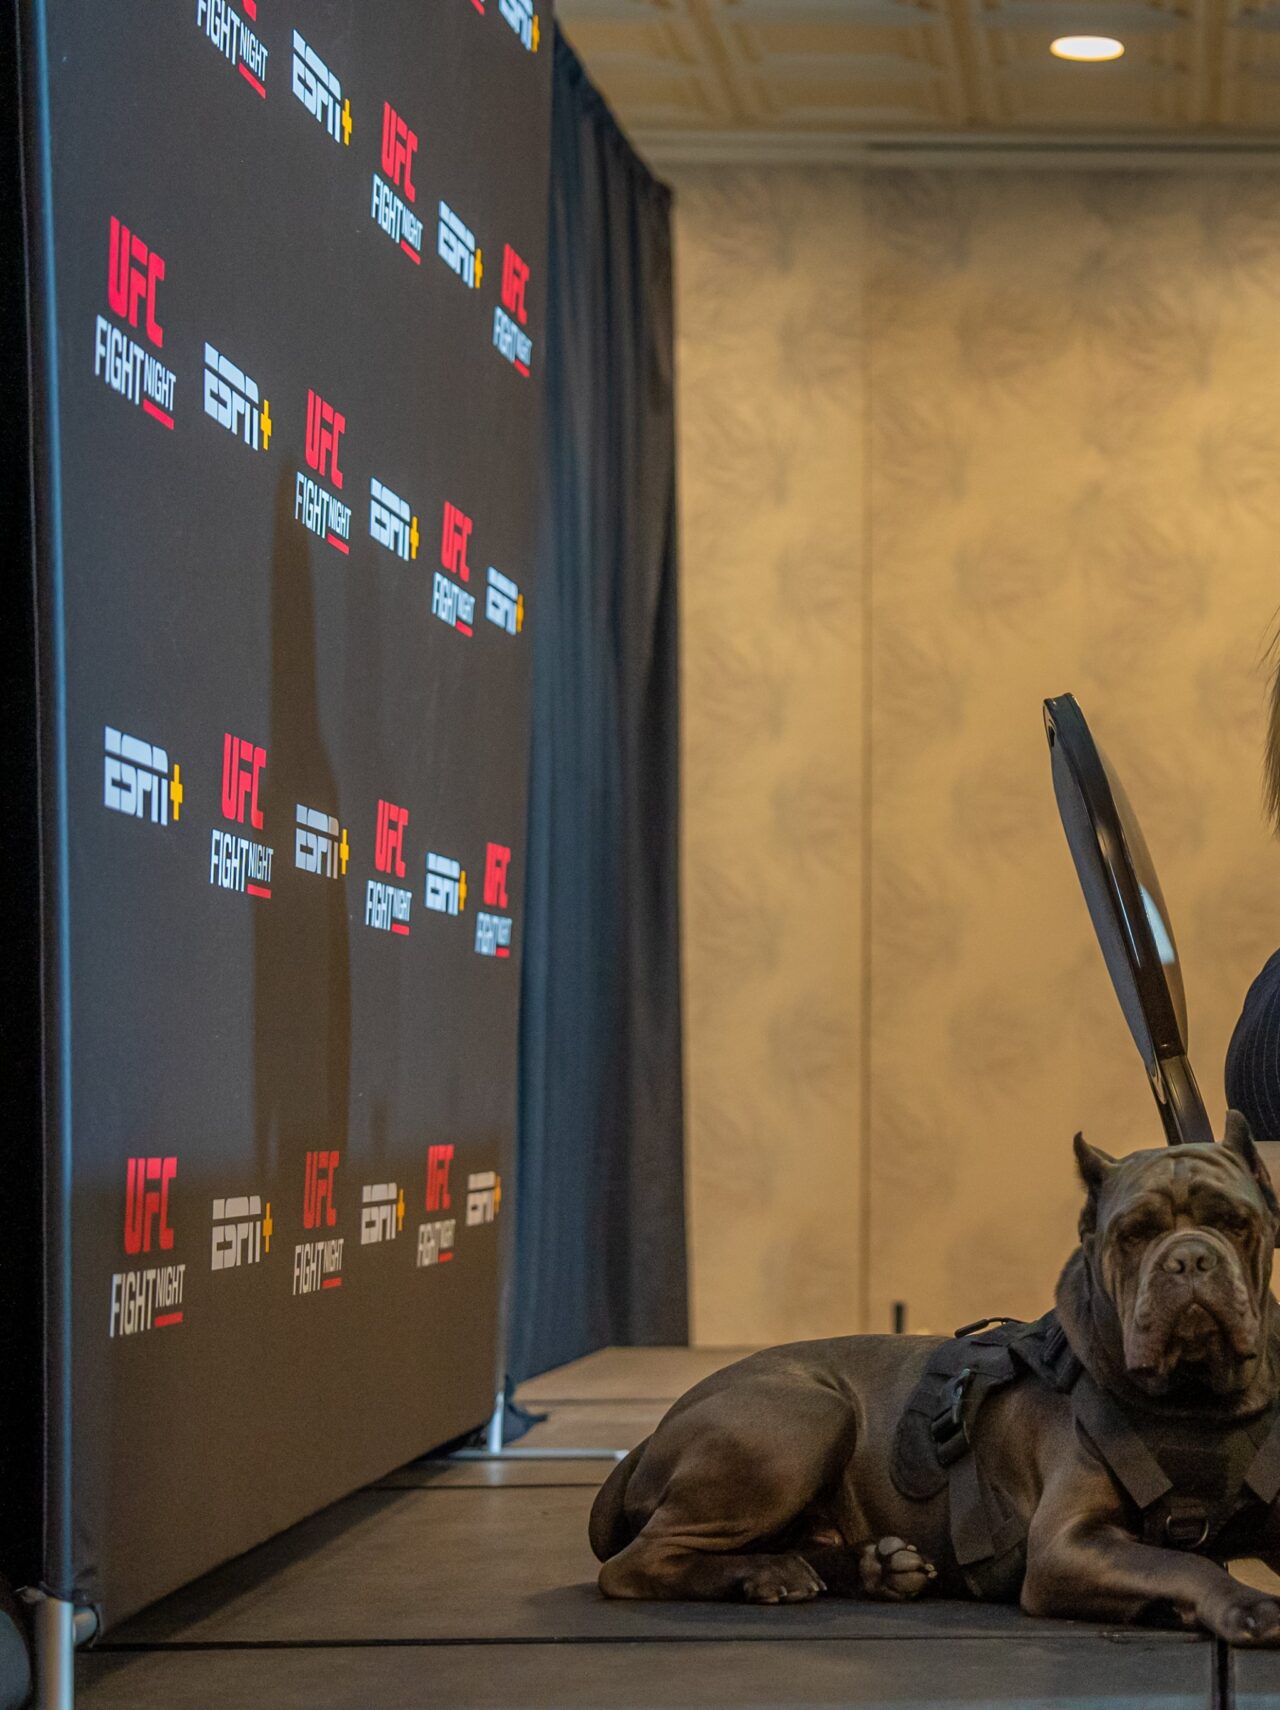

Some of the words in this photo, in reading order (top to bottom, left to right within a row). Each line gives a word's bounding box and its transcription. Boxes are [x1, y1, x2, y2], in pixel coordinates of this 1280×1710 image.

[381, 101, 418, 202] UFC
[371, 173, 404, 244] FIGHT
[109, 216, 165, 348] UFC
[95, 314, 145, 406] FIGHT
[144, 353, 177, 412] NIGHT
[204, 342, 272, 451] ESPN+
[305, 389, 346, 489] UFC
[295, 472, 330, 539] FIGHT
[328, 495, 352, 540] NIGHT
[441, 501, 473, 582] UFC
[104, 726, 183, 826] ESPN+
[222, 733, 266, 830] UFC
[210, 828, 249, 893] FIGHT
[248, 842, 274, 882] NIGHT
[295, 804, 349, 879] ESPN+
[375, 799, 410, 879] UFC
[365, 880, 394, 932] FIGHT
[124, 1157, 178, 1255] UFC
[304, 1151, 341, 1230] UFC
[211, 1195, 274, 1271] ESPN+
[293, 1241, 325, 1296] FIGHT
[109, 1269, 157, 1339] FIGHT
[155, 1264, 187, 1308] NIGHT
